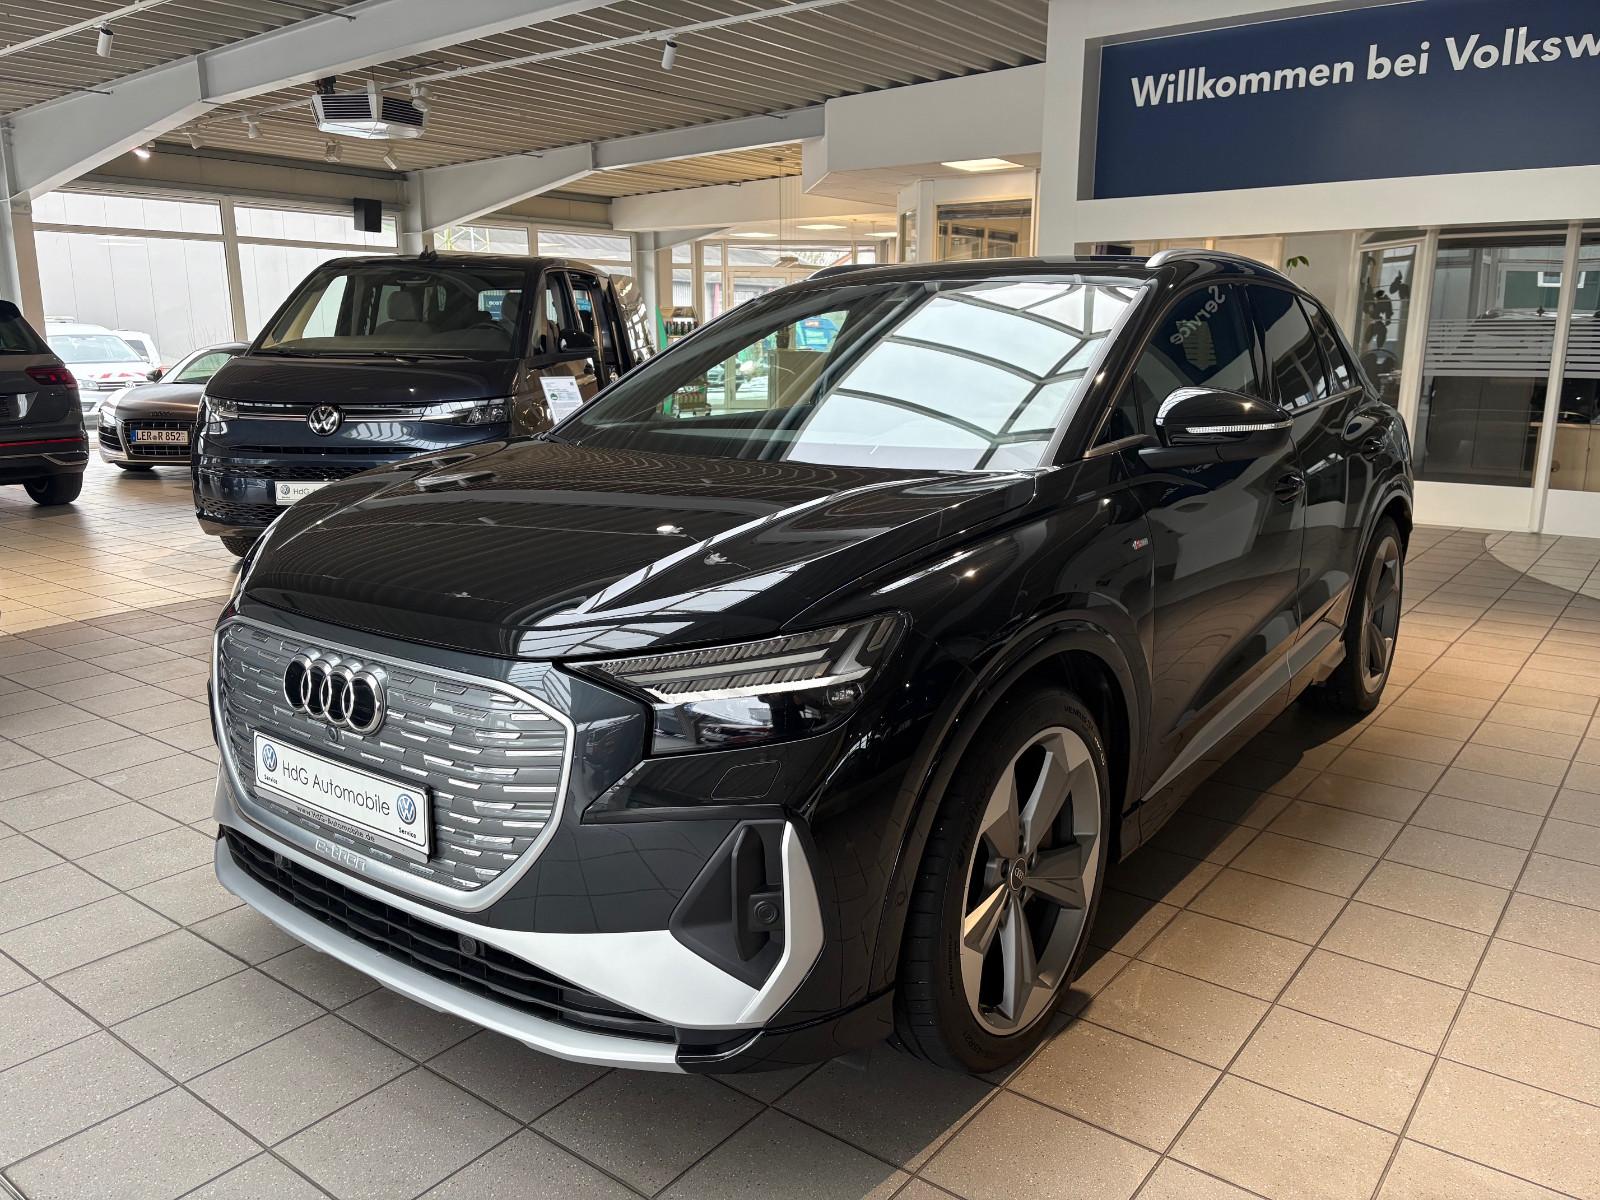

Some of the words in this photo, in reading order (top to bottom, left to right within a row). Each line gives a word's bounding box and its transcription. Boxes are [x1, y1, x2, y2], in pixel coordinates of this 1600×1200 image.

[1131, 60, 1354, 108] Willkommen
[1367, 41, 1430, 80] bei
[1445, 26, 1600, 72] Volksw
[136, 431, 152, 441] LER
[165, 431, 181, 441] 852
[282, 759, 309, 786] HdG
[312, 774, 391, 816] Automobile
